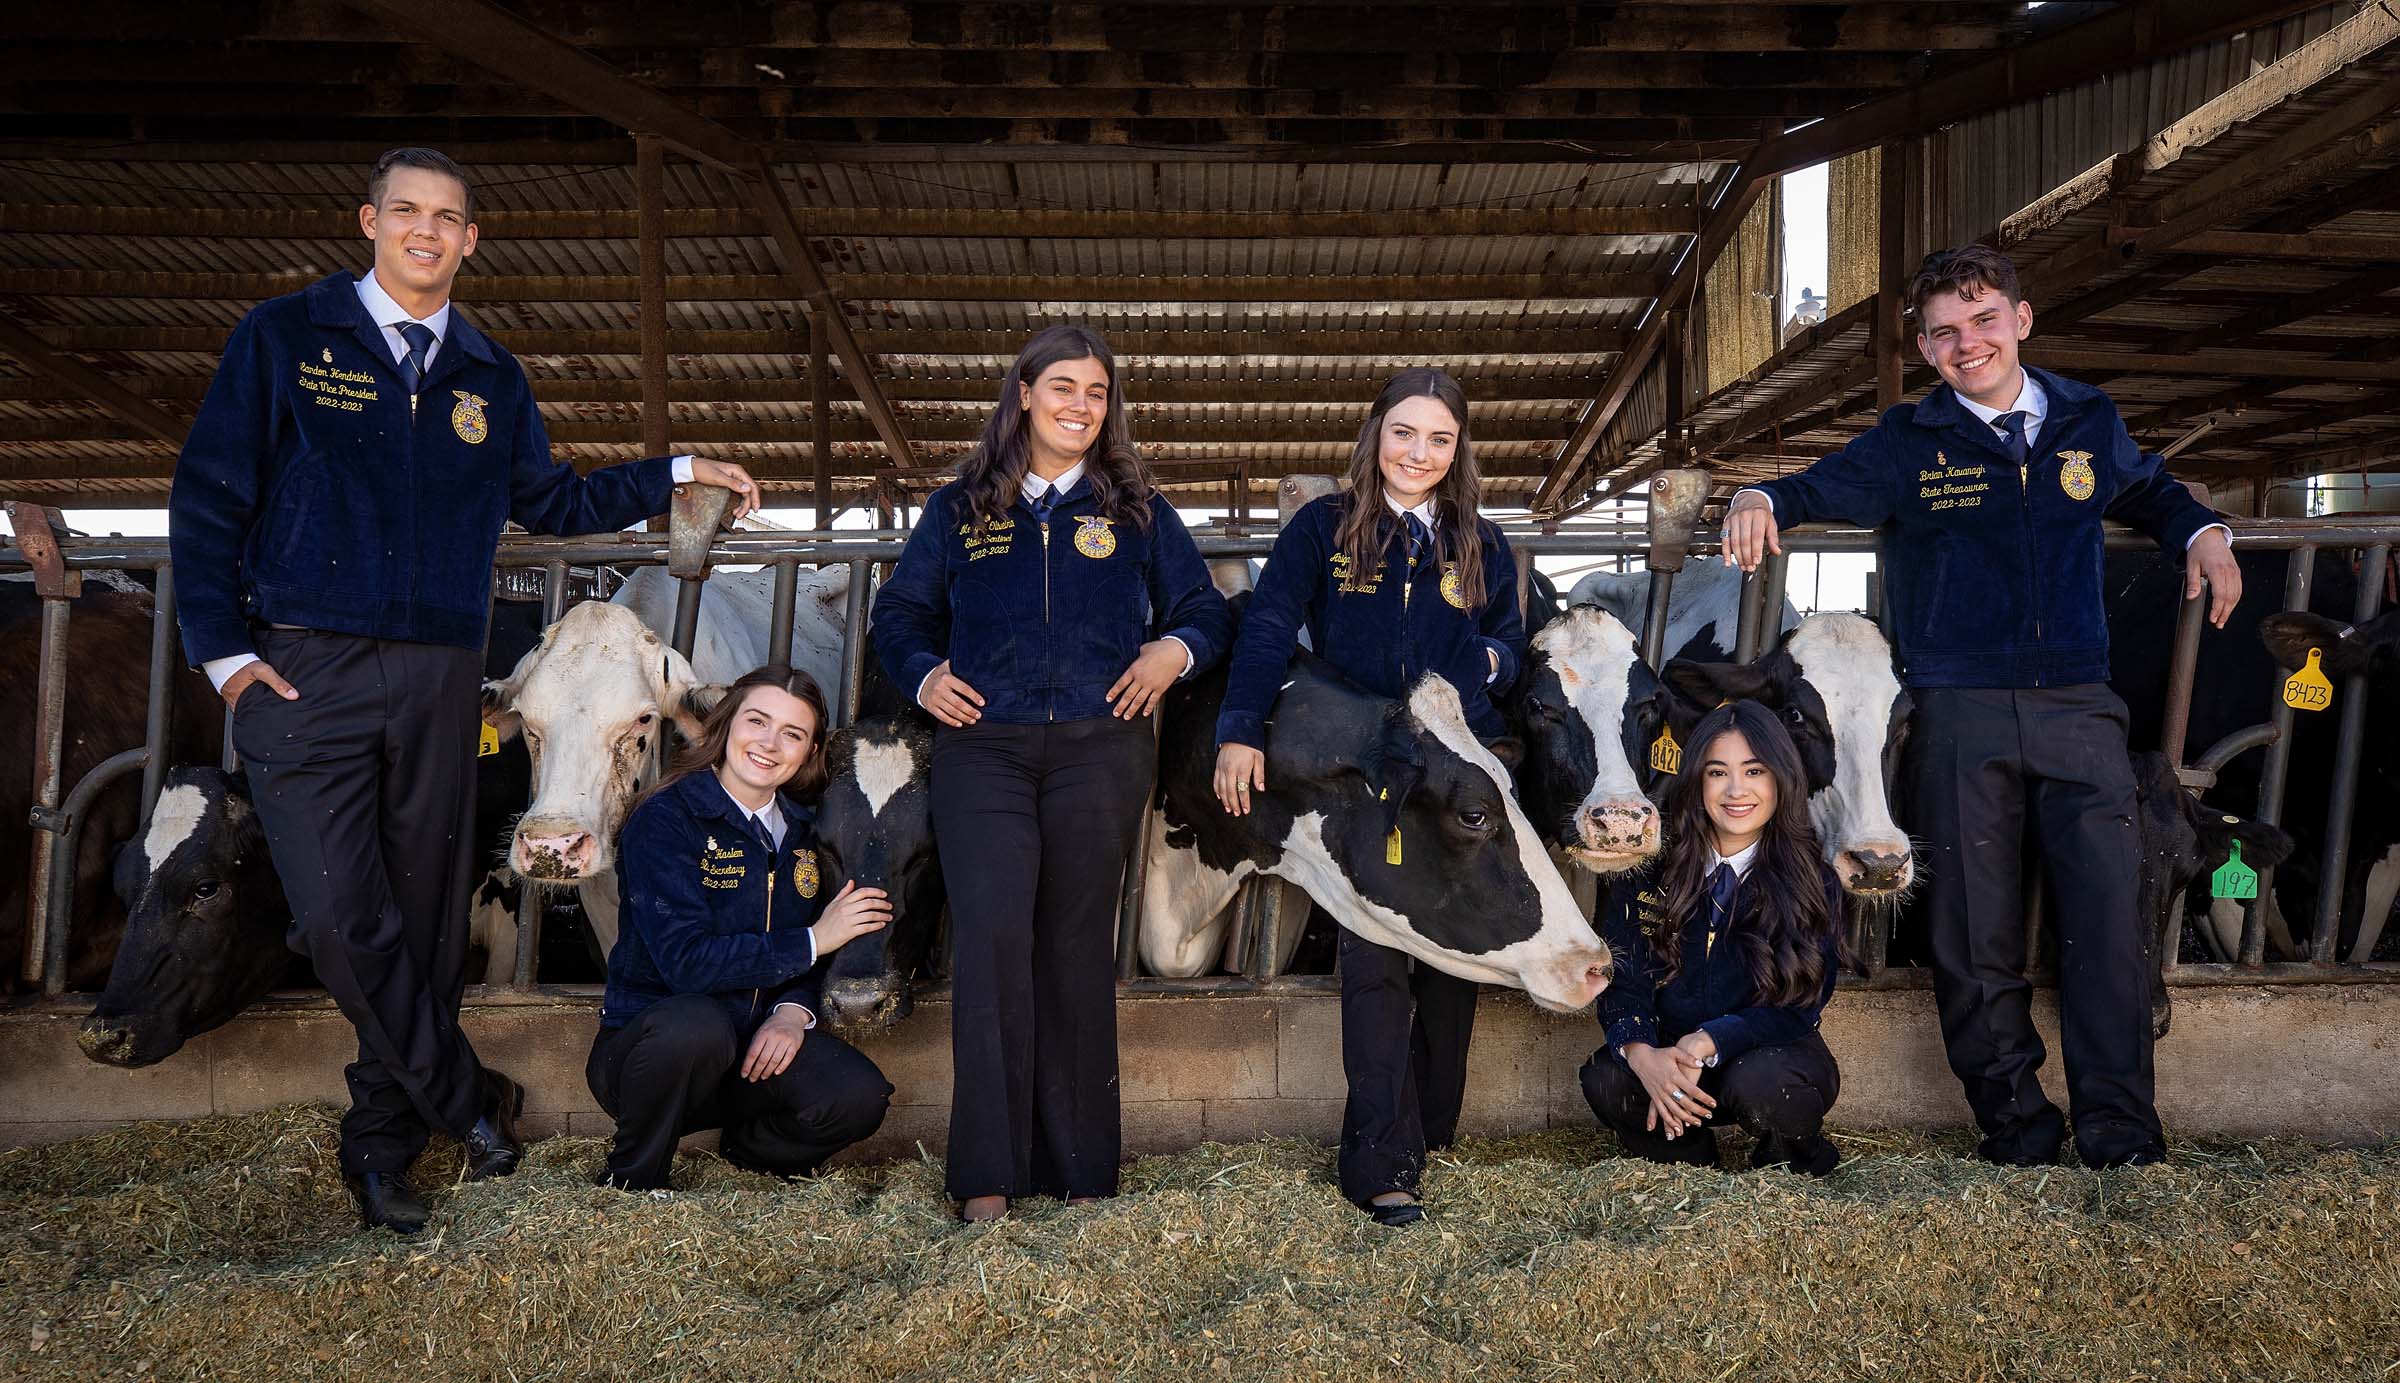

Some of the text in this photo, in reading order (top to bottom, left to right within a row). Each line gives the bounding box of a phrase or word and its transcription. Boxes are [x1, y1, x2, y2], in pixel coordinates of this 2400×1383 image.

[330, 367, 375, 383] Hendricks
[319, 381, 337, 394] Vice
[338, 384, 378, 400] President
[315, 396, 363, 412] 2022-2023
[1919, 464, 1986, 481] Brian Kavanagh
[1920, 483, 1990, 498] State Treasurer
[1931, 496, 1981, 511] 2022-2023
[2286, 680, 2327, 705] 8423
[1662, 738, 1673, 747] SB
[2221, 871, 2256, 897] 197
